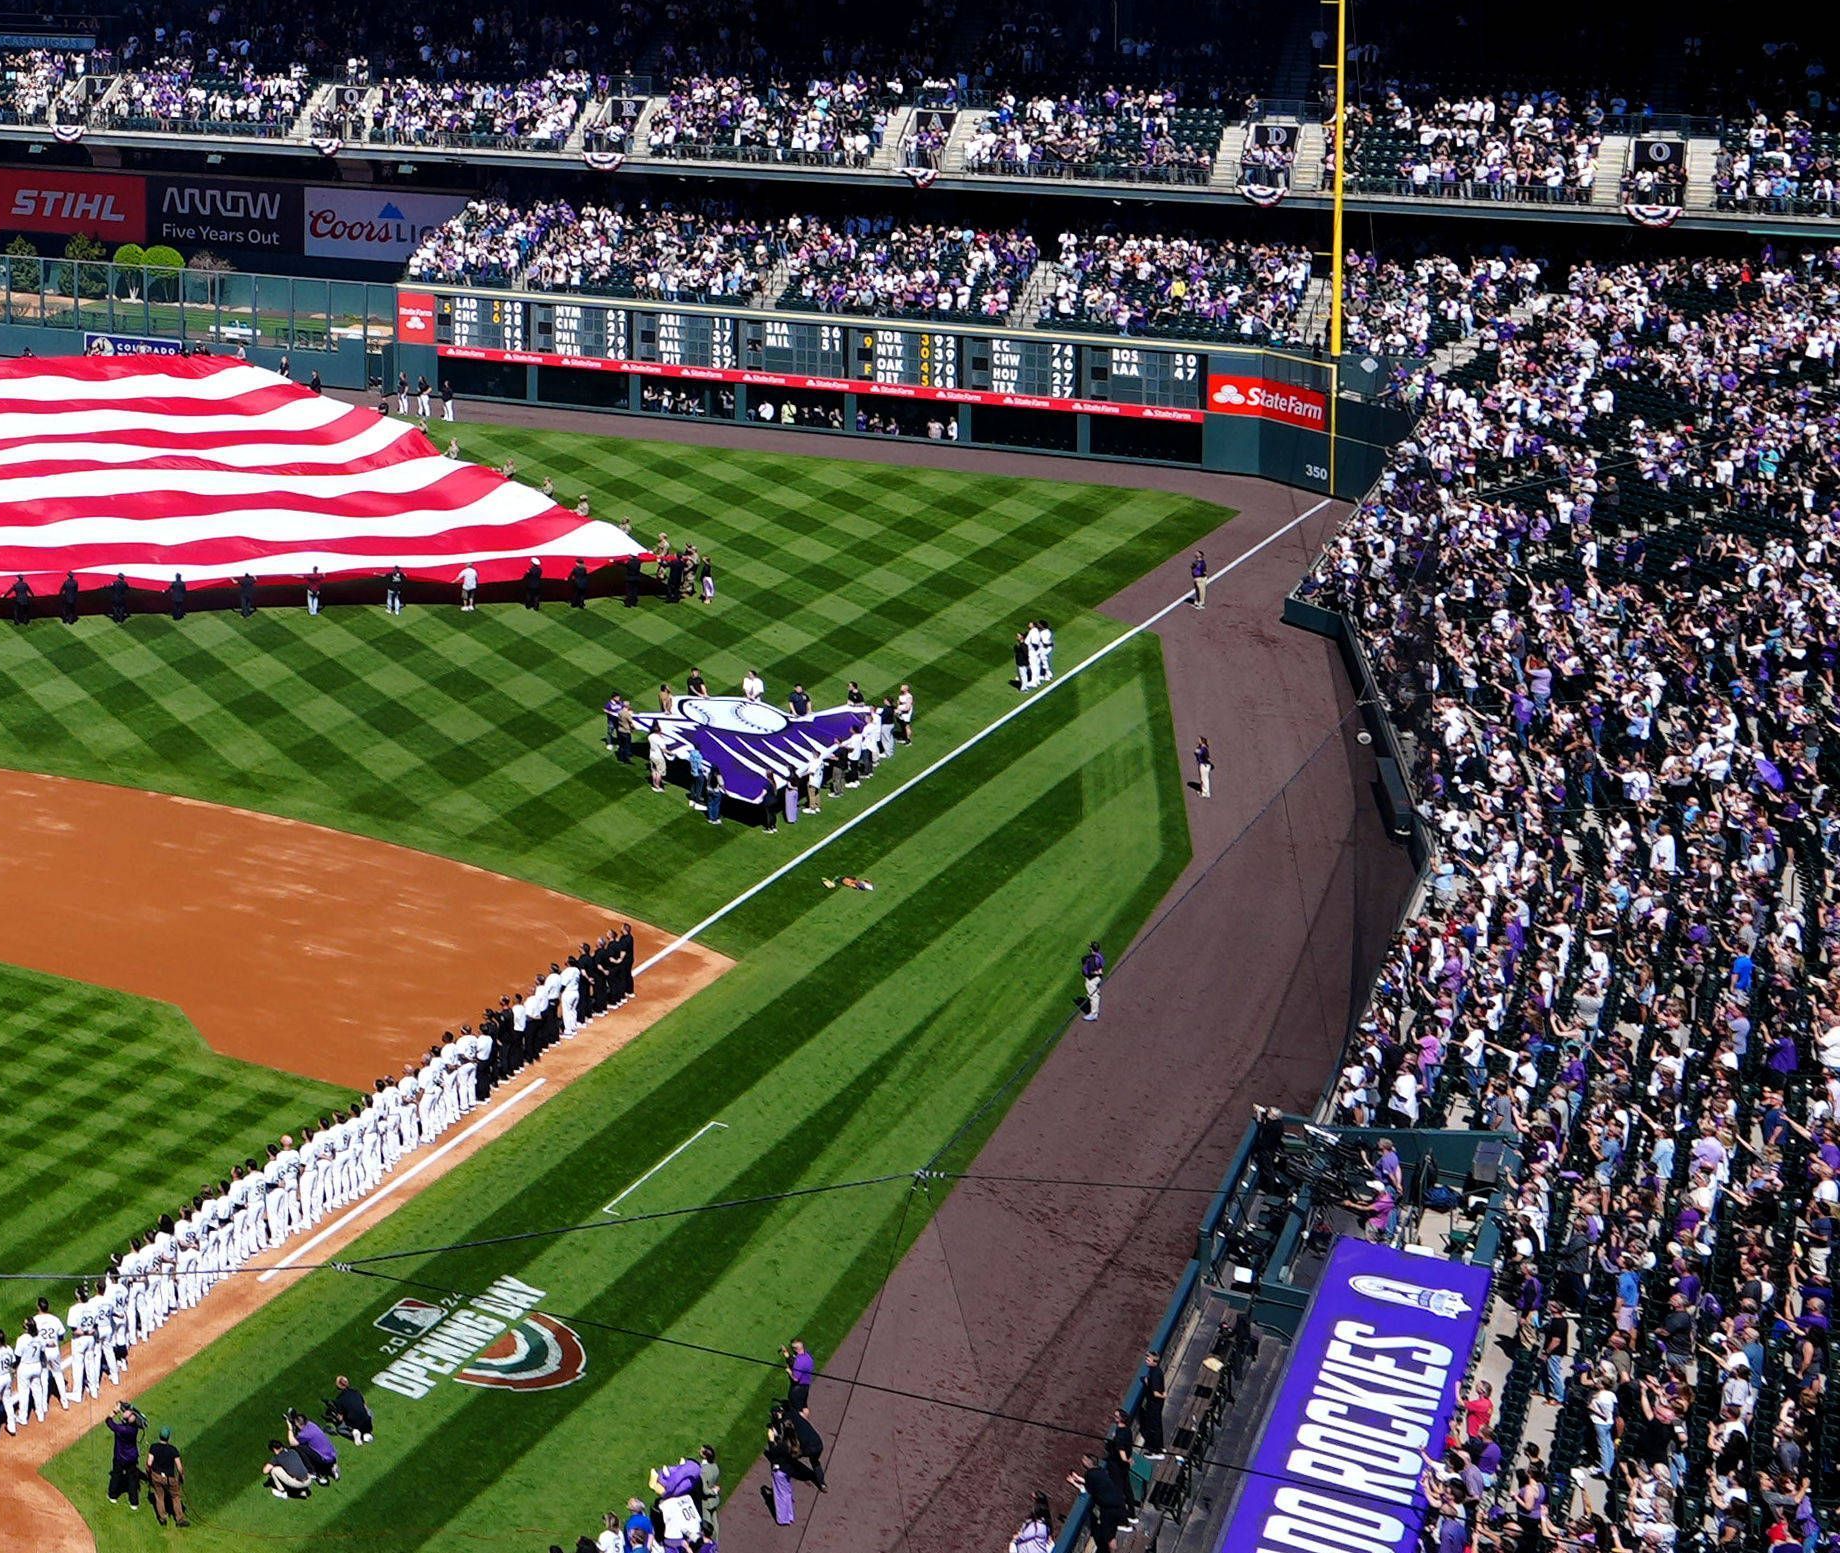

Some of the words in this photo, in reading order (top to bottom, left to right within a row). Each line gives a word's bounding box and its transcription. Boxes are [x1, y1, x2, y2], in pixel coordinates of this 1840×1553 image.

[1266, 126, 1287, 146] D
[1648, 141, 1672, 162] O
[11, 189, 125, 223] STIHL
[309, 209, 392, 242] Coors
[162, 222, 196, 240] Five
[198, 225, 245, 244] Years
[250, 227, 280, 245] Out
[456, 298, 478, 309] LAD
[455, 310, 478, 322] CHC
[556, 305, 582, 318] NYM
[556, 318, 577, 330] CIN
[659, 314, 681, 326] ARI
[454, 323, 469, 334] SD
[765, 322, 790, 335] SEA
[556, 332, 576, 343] PHI
[766, 336, 790, 348] MIL
[877, 331, 902, 344] TOR
[556, 344, 581, 356] WSH
[876, 344, 903, 357] NYY
[992, 340, 1010, 352] KC
[662, 354, 682, 366] PIT
[993, 354, 1020, 366] CHW
[1112, 348, 1139, 362] BOS
[876, 358, 904, 371] OAK
[1112, 362, 1140, 376] LAA
[876, 372, 899, 384] DET
[993, 368, 1018, 380] HOU
[992, 381, 1016, 394] TEX
[1305, 464, 1328, 481] 350
[40, 1327, 56, 1340] 22
[371, 1308, 508, 1400] OPENING
[469, 1274, 547, 1321] DAY
[1286, 1320, 1454, 1505] ROCKIES
